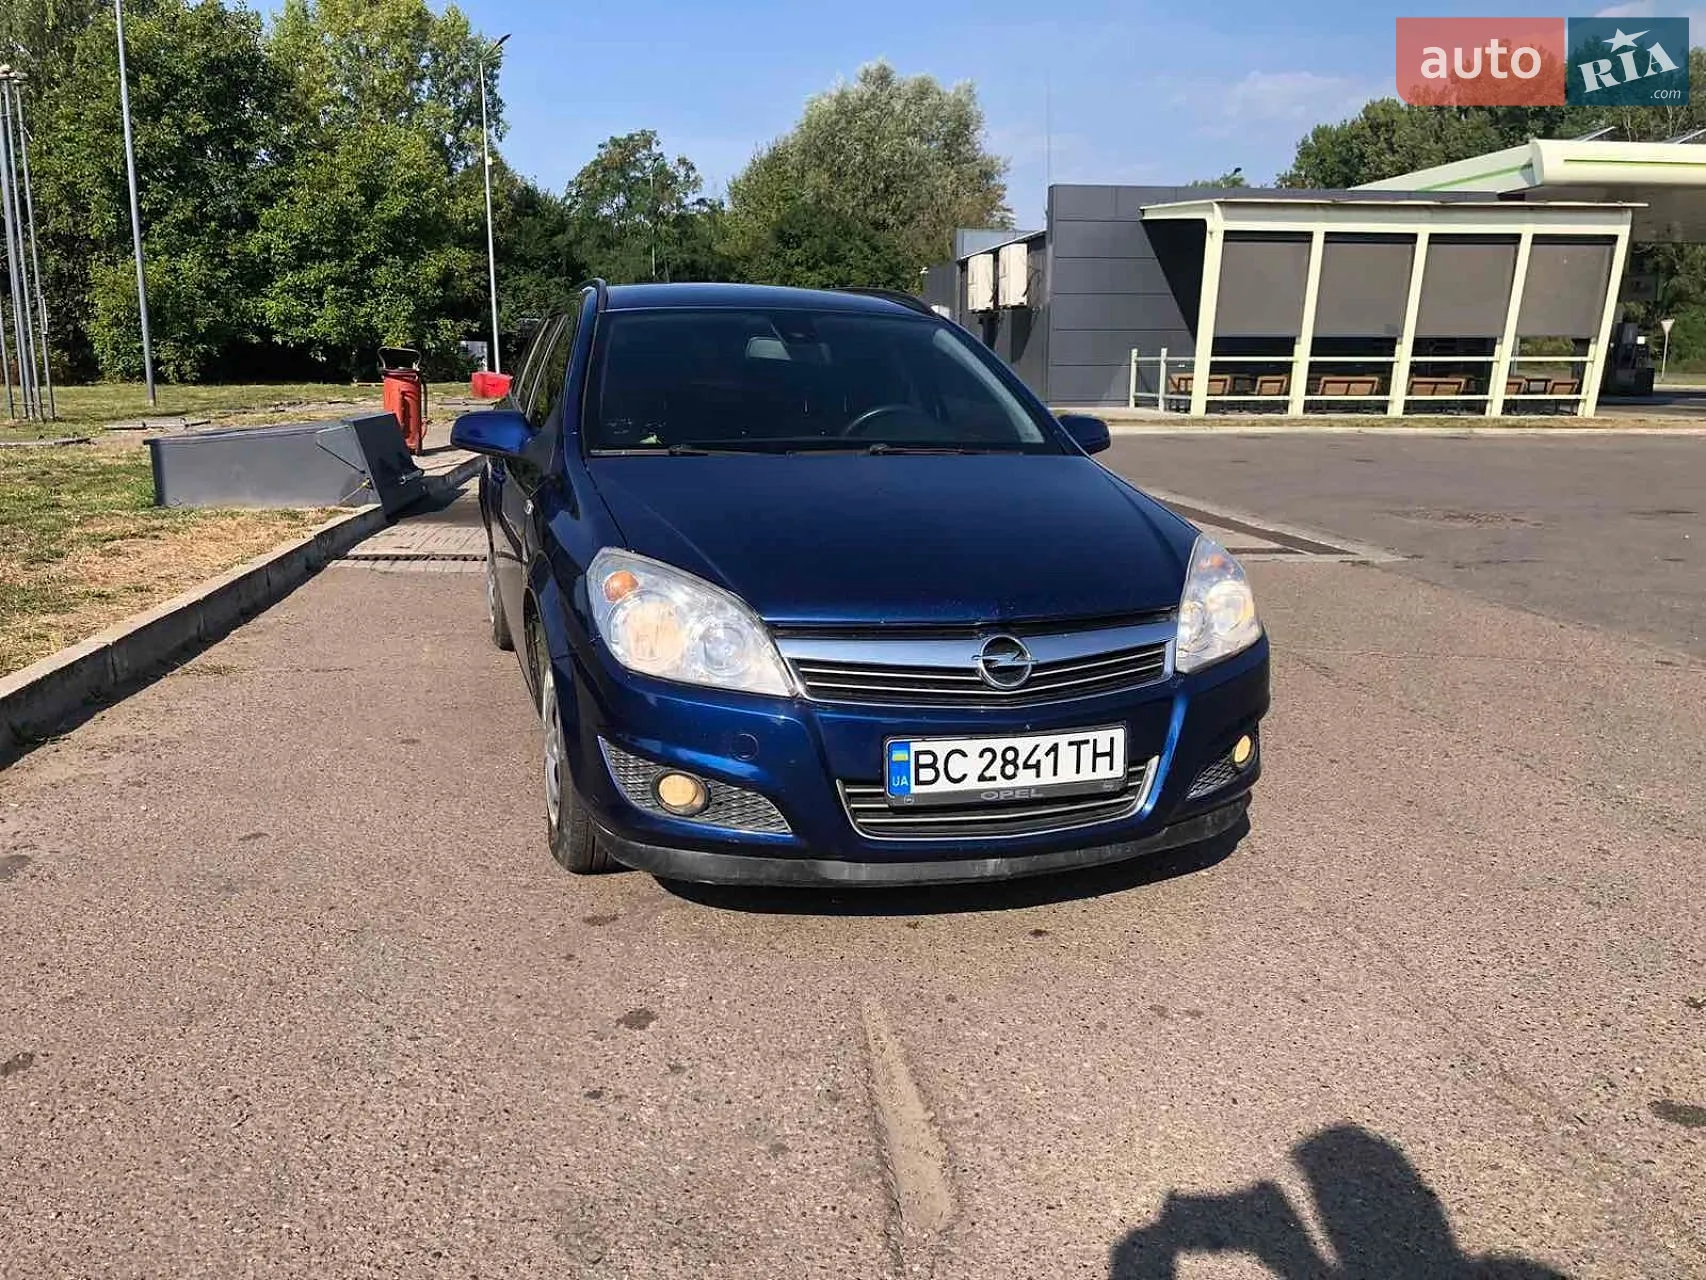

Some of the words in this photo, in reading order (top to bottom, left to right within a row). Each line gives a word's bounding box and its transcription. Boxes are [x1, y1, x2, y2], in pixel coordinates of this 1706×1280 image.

[914, 749, 968, 786] BC
[977, 743, 1059, 782] 2841
[1068, 737, 1115, 774] TH
[892, 776, 909, 787] UA
[980, 787, 1043, 800] OPEL
